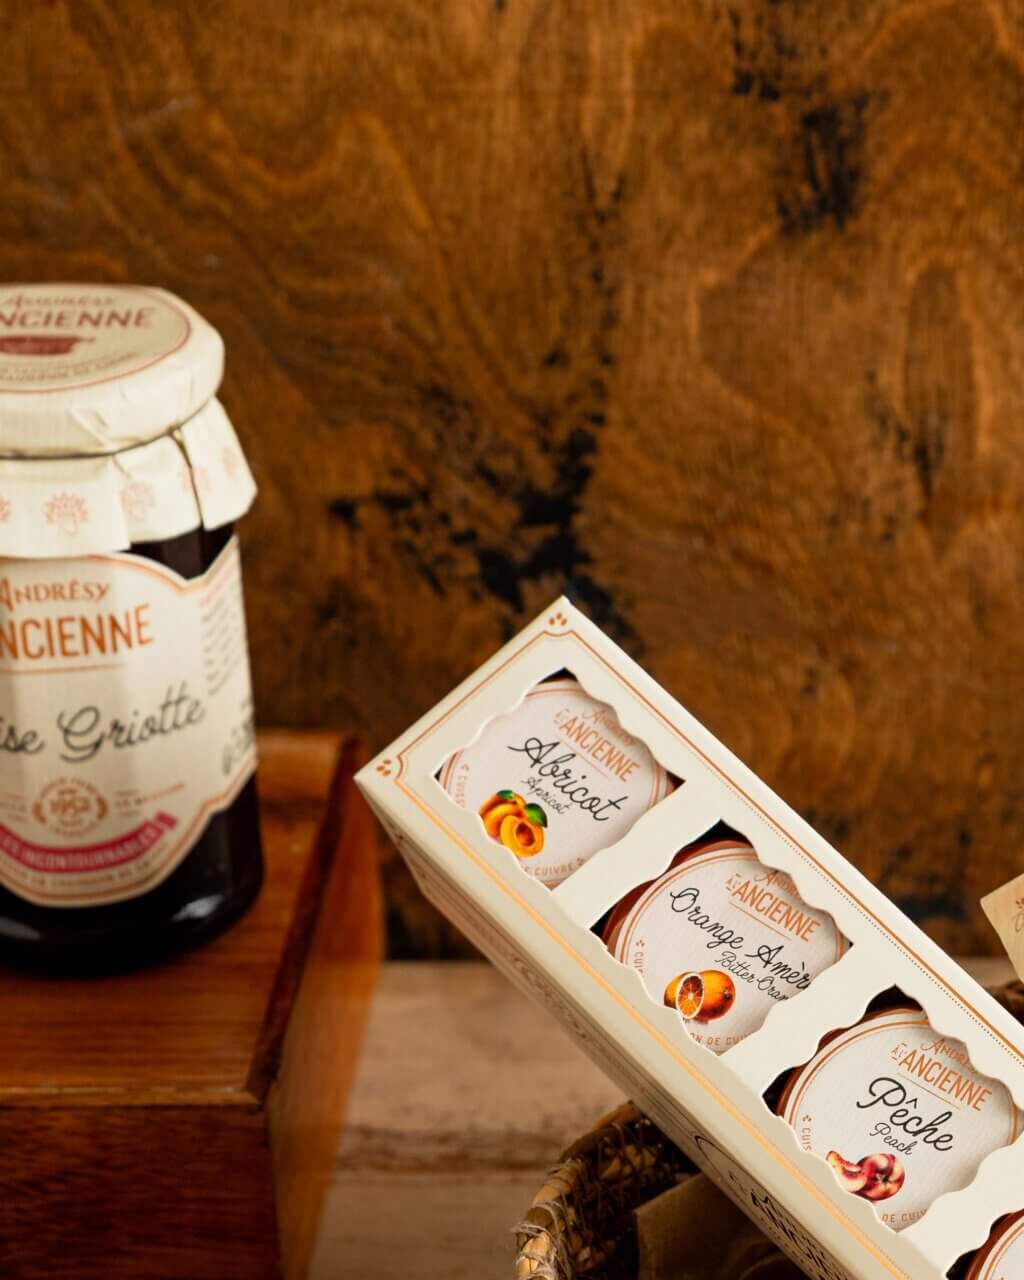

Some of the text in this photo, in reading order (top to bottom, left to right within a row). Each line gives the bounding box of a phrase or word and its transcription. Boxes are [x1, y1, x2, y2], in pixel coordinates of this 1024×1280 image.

[0, 307, 157, 329] NCIENNE
[0, 602, 154, 661] NCIENNE
[56, 679, 206, 764] Griotte
[506, 736, 629, 822] Abricot
[520, 776, 571, 815] Apricot
[670, 887, 813, 990] Orange Amèr
[714, 951, 755, 984] Bitter
[856, 1077, 954, 1152] Pêche
[869, 1122, 919, 1156] Peach
[882, 1213, 897, 1223] DE
